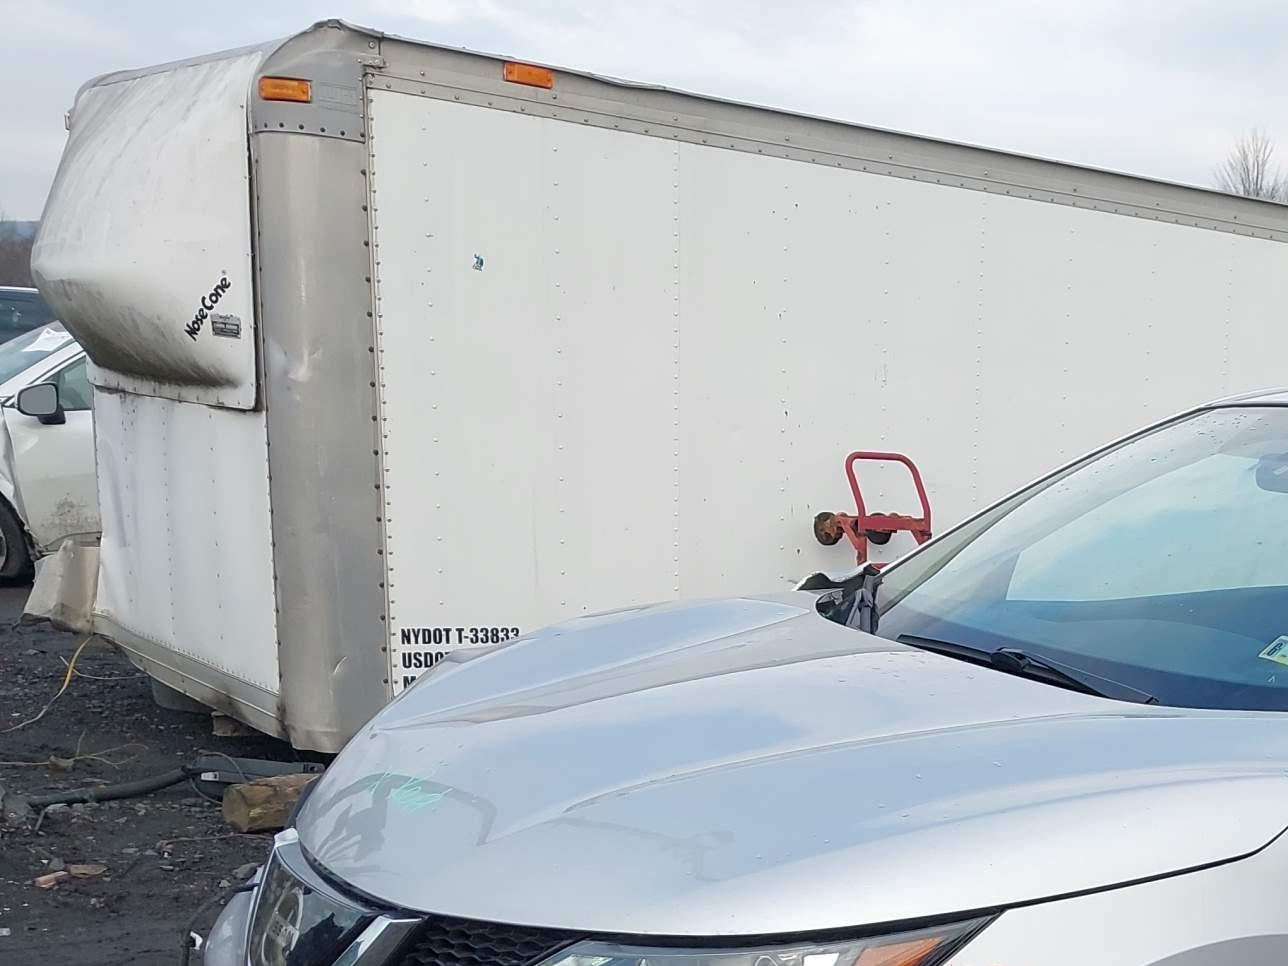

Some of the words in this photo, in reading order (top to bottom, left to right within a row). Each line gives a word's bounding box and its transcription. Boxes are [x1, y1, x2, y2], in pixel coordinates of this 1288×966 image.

[401, 628, 452, 645] NYDOT
[456, 628, 520, 644] T-33833
[402, 652, 450, 668] USDO
